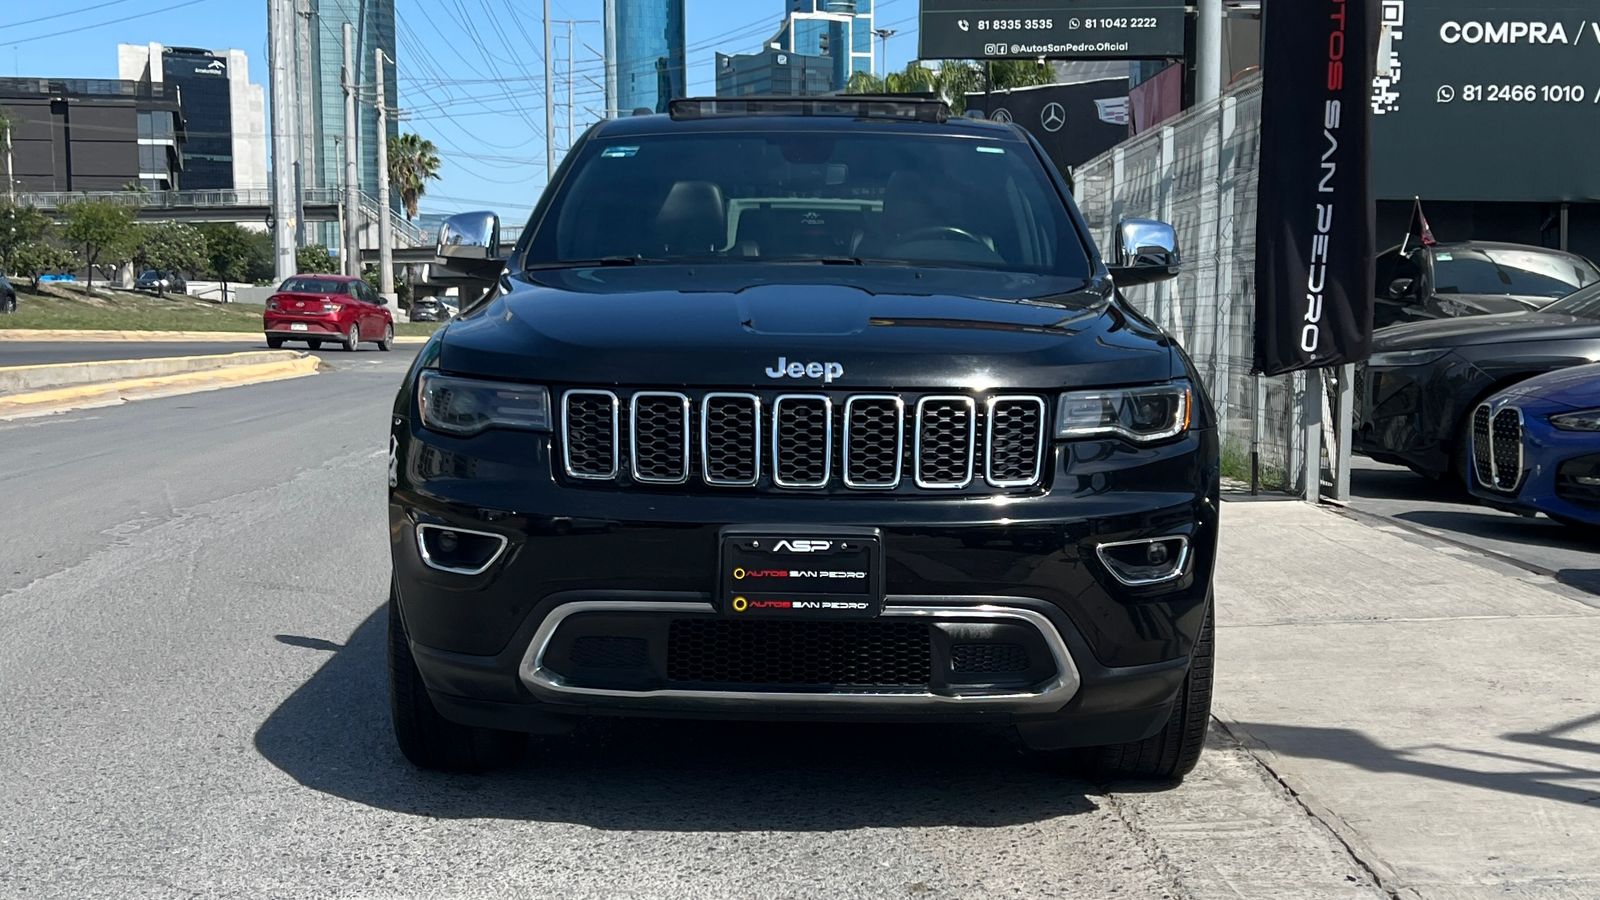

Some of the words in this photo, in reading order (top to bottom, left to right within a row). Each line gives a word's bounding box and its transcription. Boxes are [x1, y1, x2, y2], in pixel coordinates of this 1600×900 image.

[977, 20, 990, 30] 81
[993, 19, 1021, 30] 8335
[1024, 19, 1053, 30] 3535
[1085, 18, 1097, 29] 81
[1100, 18, 1128, 29] 1042
[1130, 17, 1157, 28] 2222
[1439, 21, 1569, 44] COMPRA
[1010, 42, 1129, 54] @AutosSanPedro.Oficial
[1328, 0, 1346, 90] TOS
[1462, 84, 1483, 101] 81
[1487, 84, 1537, 102] 2466
[1541, 85, 1585, 102] 1010
[1318, 99, 1341, 192] SAN
[1301, 203, 1333, 352] PEDRO
[765, 356, 844, 383] Jeep
[772, 540, 833, 552] ASP
[789, 570, 818, 578] SAN
[819, 571, 867, 579] PEDRO
[749, 601, 791, 609] AUTOS
[792, 601, 820, 609] SAN
[821, 602, 869, 610] PEDRO
